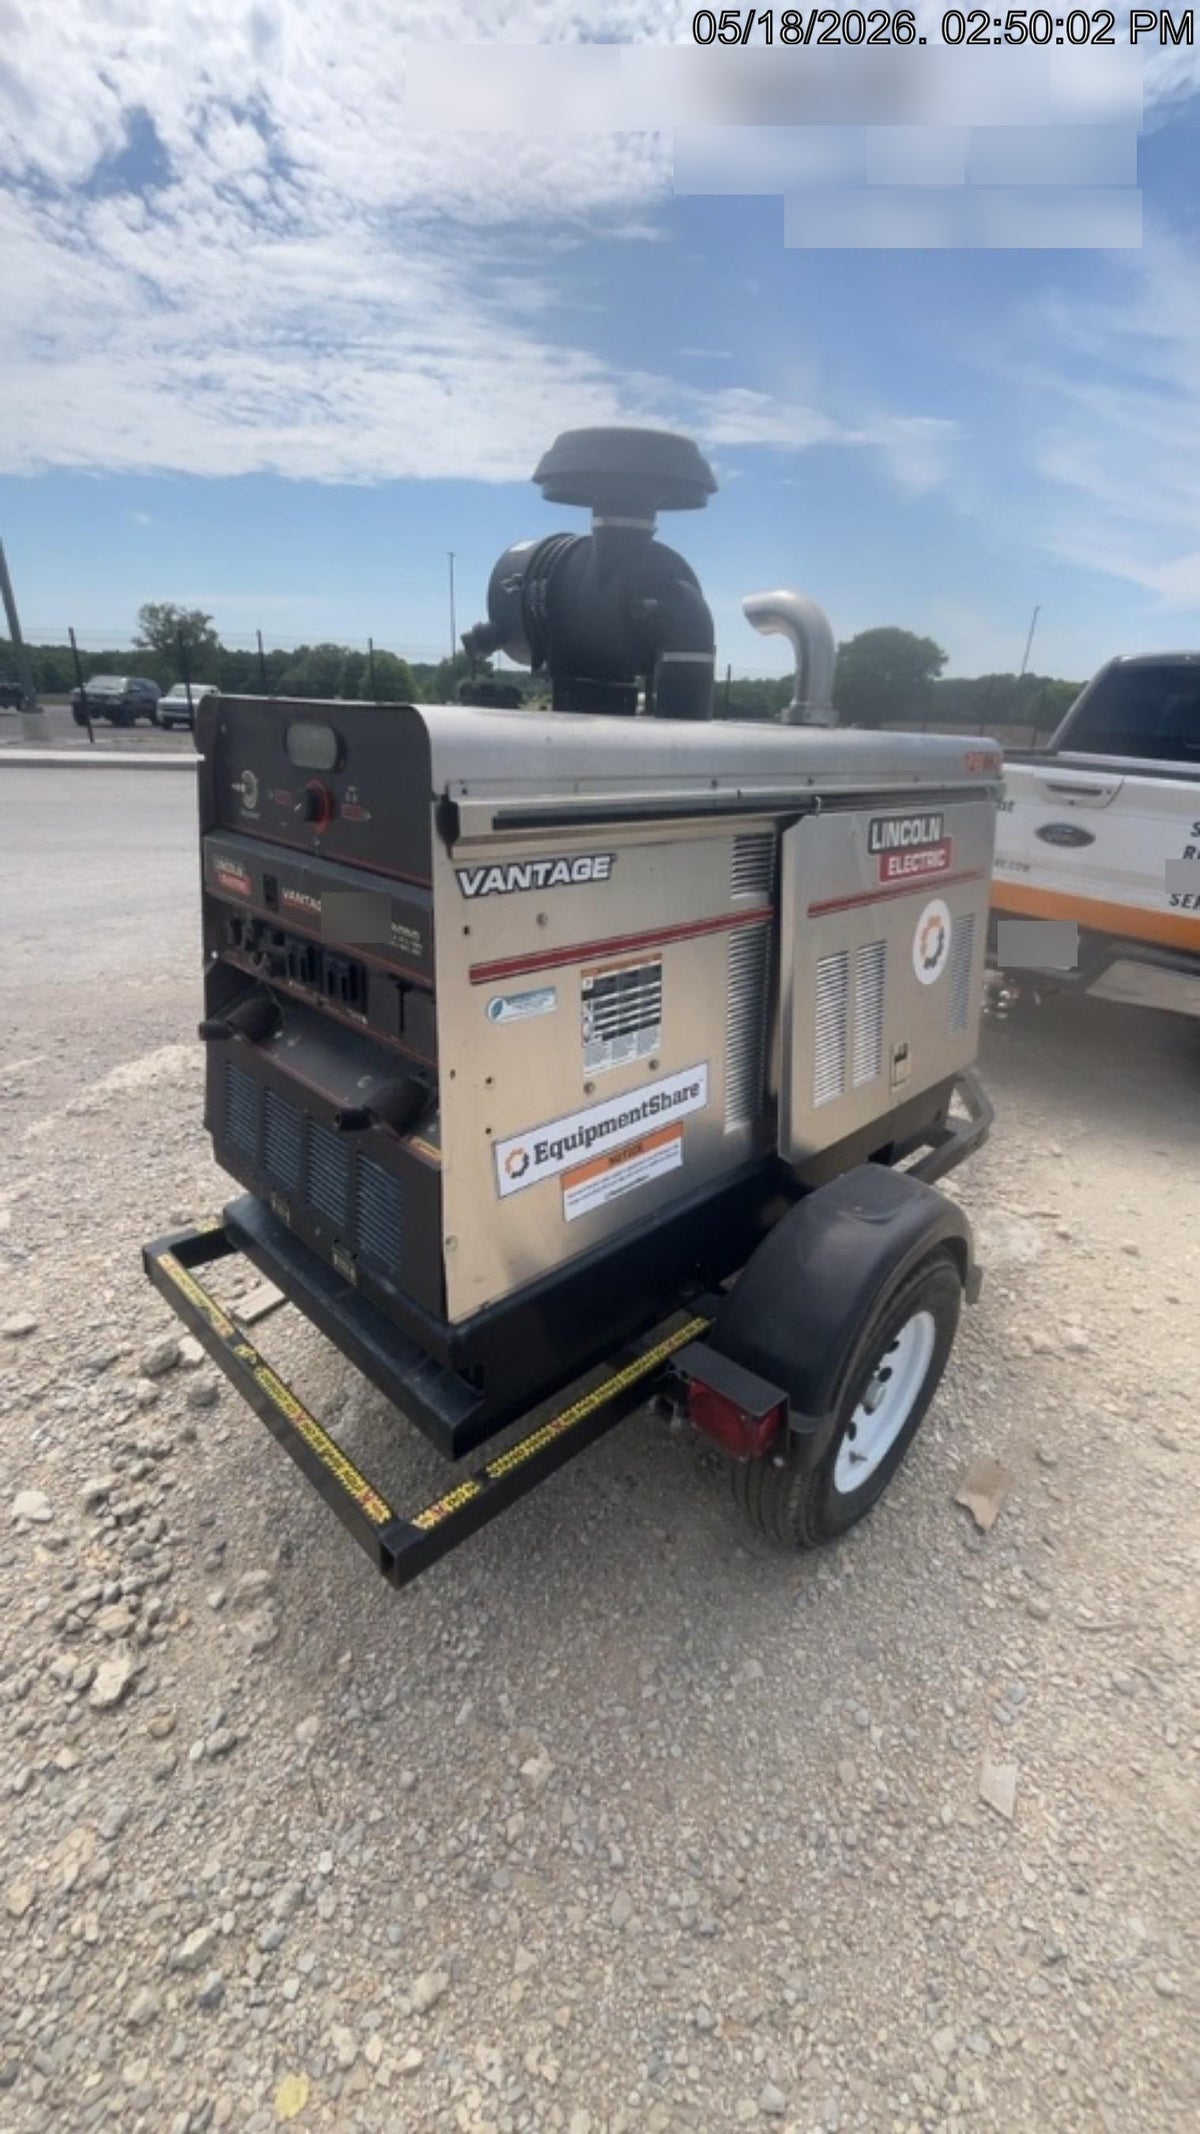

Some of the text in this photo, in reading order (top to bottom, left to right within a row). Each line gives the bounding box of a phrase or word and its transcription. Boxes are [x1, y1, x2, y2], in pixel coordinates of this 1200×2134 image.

[871, 817, 942, 850] LINCOLN
[457, 854, 612, 898] VANTAGE
[888, 849, 947, 876] ELECTRIC
[533, 1081, 701, 1166] EquipmentShare
